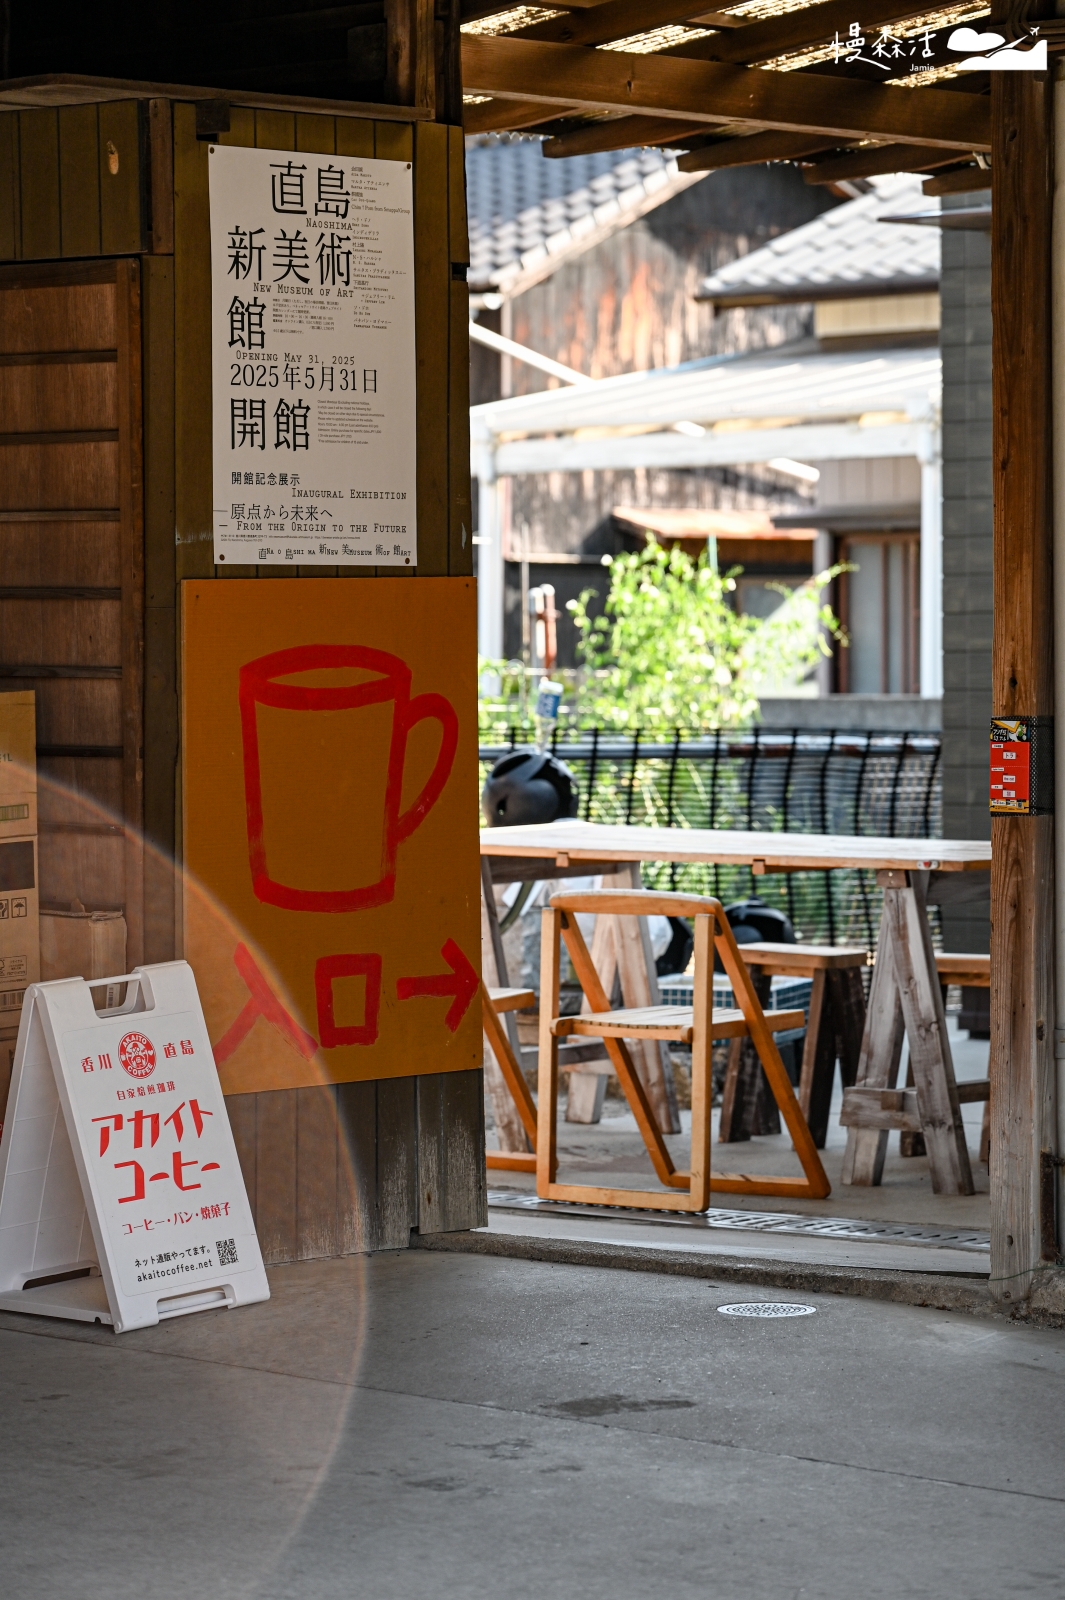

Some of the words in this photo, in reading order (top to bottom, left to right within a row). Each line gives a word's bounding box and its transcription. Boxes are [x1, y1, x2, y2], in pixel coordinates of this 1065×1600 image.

[269, 160, 351, 219] 直島
[227, 225, 353, 287] 新美術
[227, 295, 267, 351] 館
[332, 356, 355, 365] 2025
[230, 363, 377, 393] 2025年5月31日
[230, 398, 311, 451] 開館
[231, 472, 300, 487] 開館記念展示
[230, 503, 333, 521] 原点から未来へ
[268, 523, 285, 531] THE
[350, 525, 368, 533] THE
[212, 941, 382, 1070] 入口
[123, 1034, 148, 1049] AKAITO
[163, 1039, 195, 1060] 直島
[81, 1053, 113, 1073] 香川
[127, 1062, 154, 1077] COFFEE
[91, 1099, 214, 1158] アカイト
[114, 1151, 221, 1204] コーヒー
[137, 1259, 213, 1282] akaitocoffee.net
